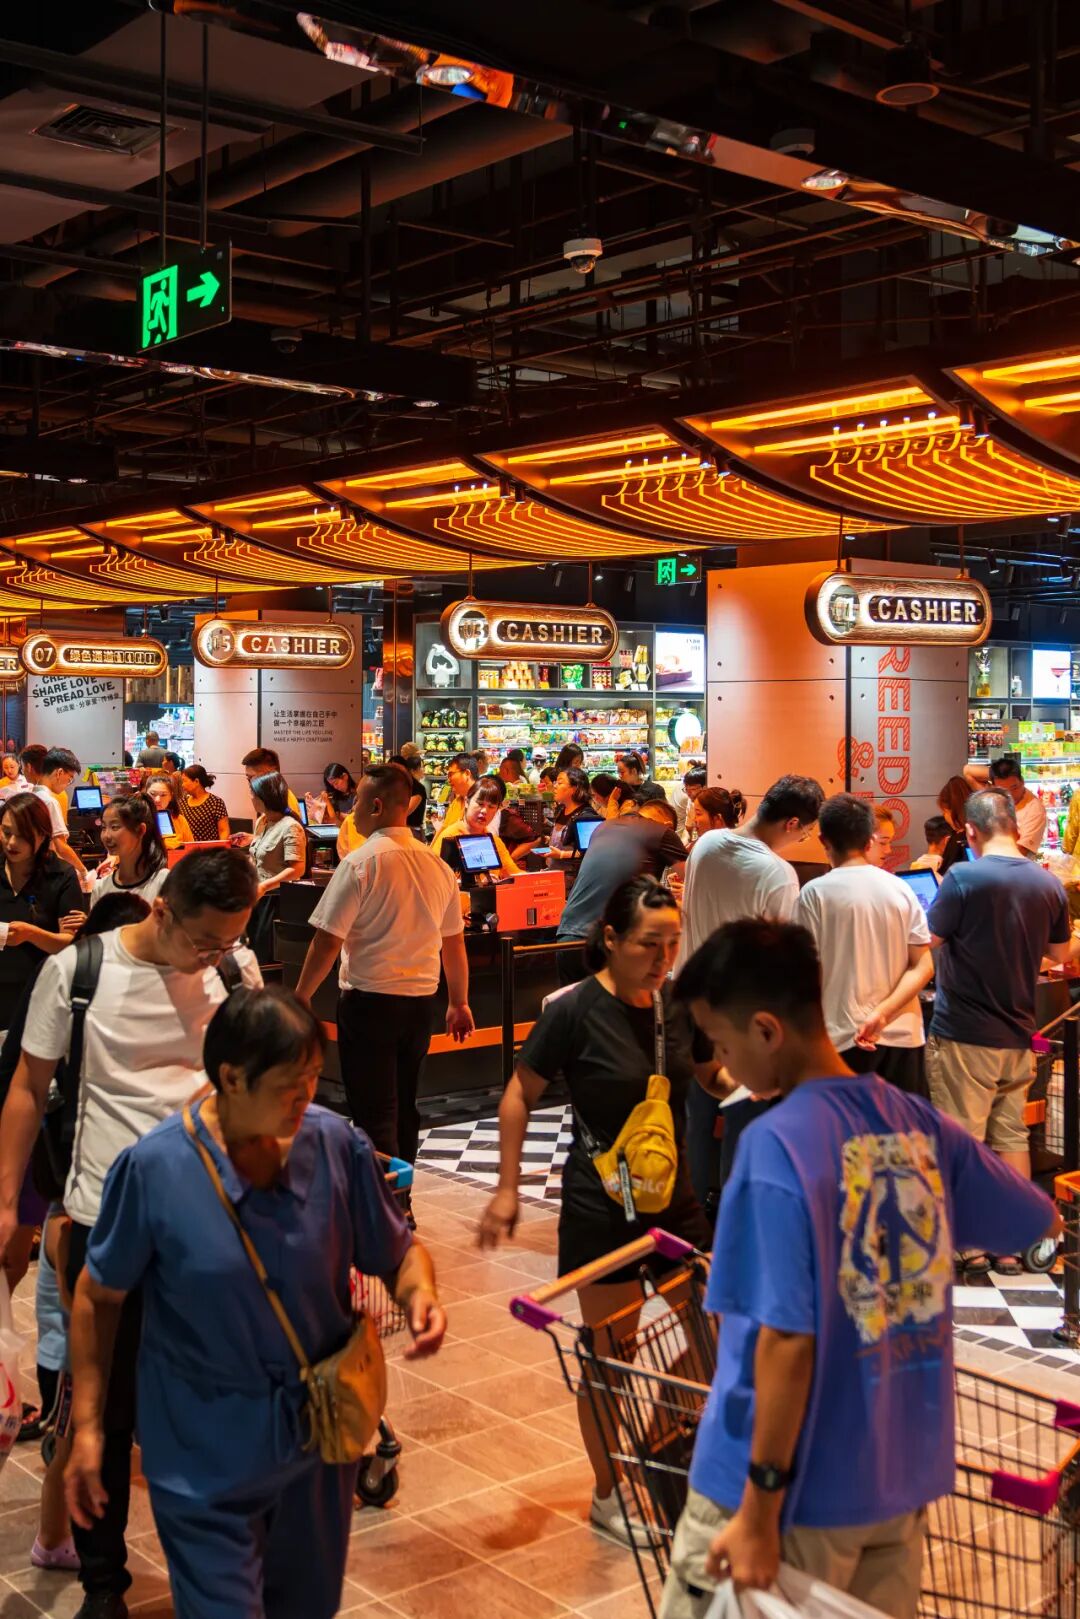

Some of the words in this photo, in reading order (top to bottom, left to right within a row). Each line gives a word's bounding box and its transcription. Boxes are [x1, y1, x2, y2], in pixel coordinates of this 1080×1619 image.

[877, 598, 977, 623] CASHIER
[506, 622, 603, 644] CASHIER
[251, 636, 341, 654] CASHIER
[34, 647, 54, 662] 07
[69, 649, 113, 664] 绿色通道
[32, 682, 68, 699] SHARE
[70, 676, 97, 689] LOVE
[43, 690, 84, 707] SPREAD
